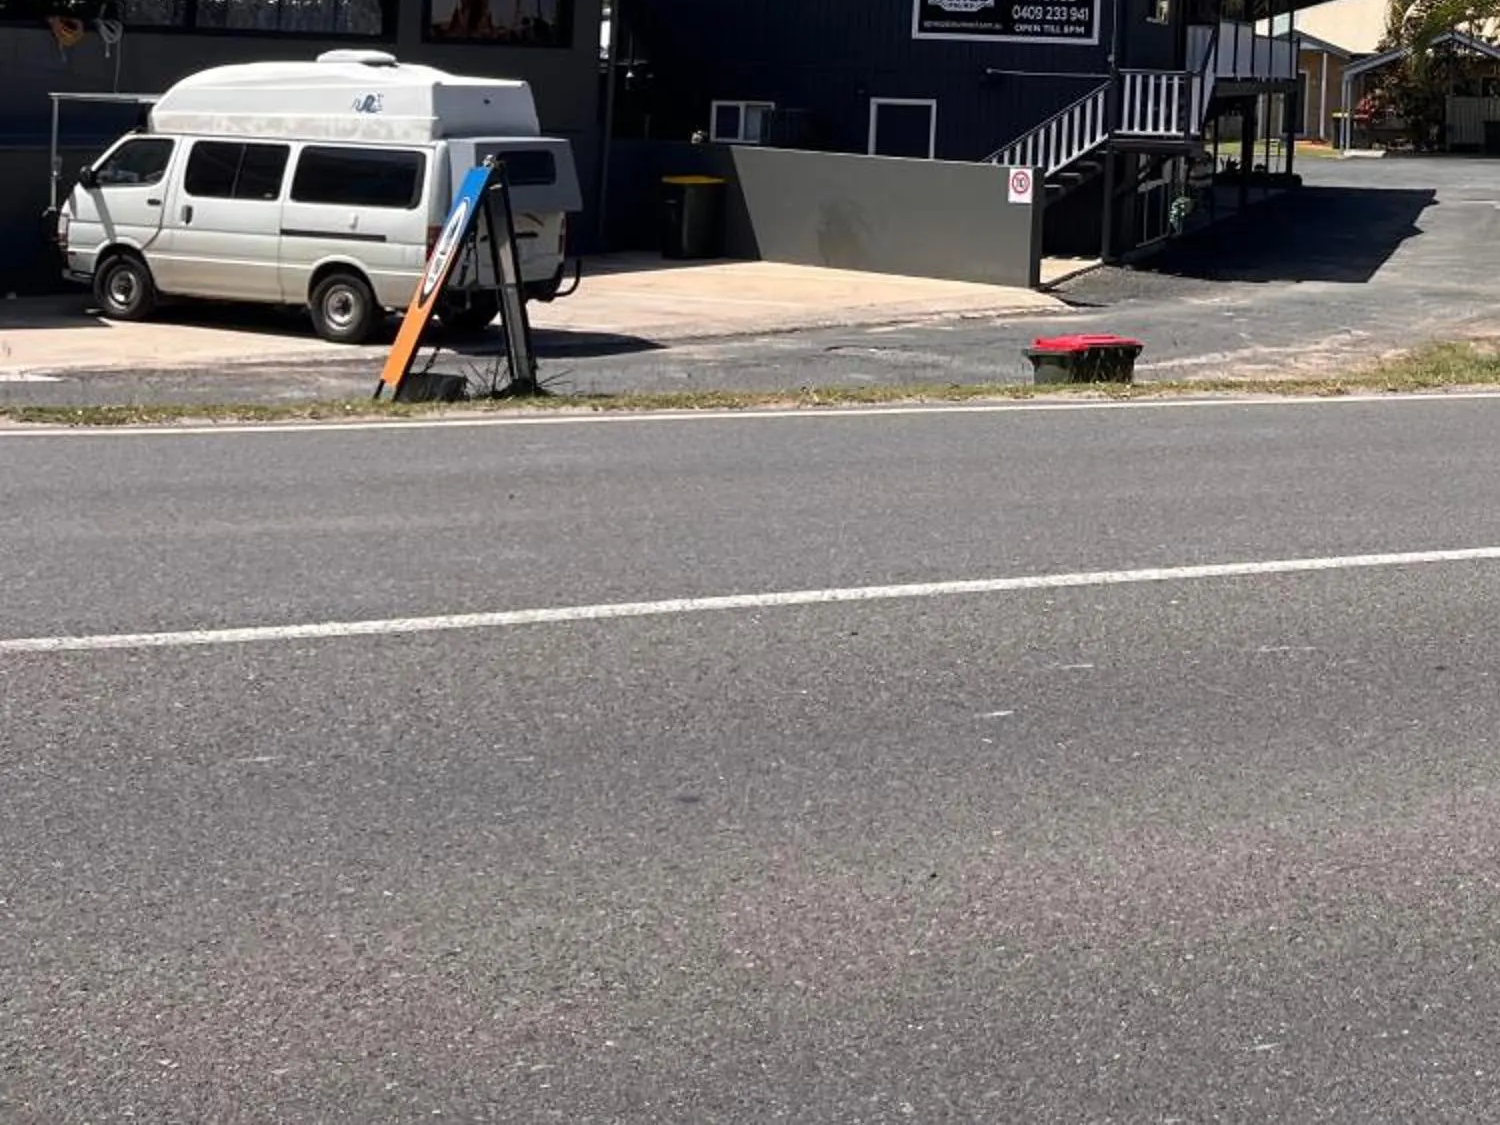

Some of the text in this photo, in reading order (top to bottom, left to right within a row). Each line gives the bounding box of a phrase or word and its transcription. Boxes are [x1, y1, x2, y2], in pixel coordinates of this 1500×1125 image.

[1011, 5, 1089, 21] 0409 233 941
[1014, 24, 1041, 33] OPEN
